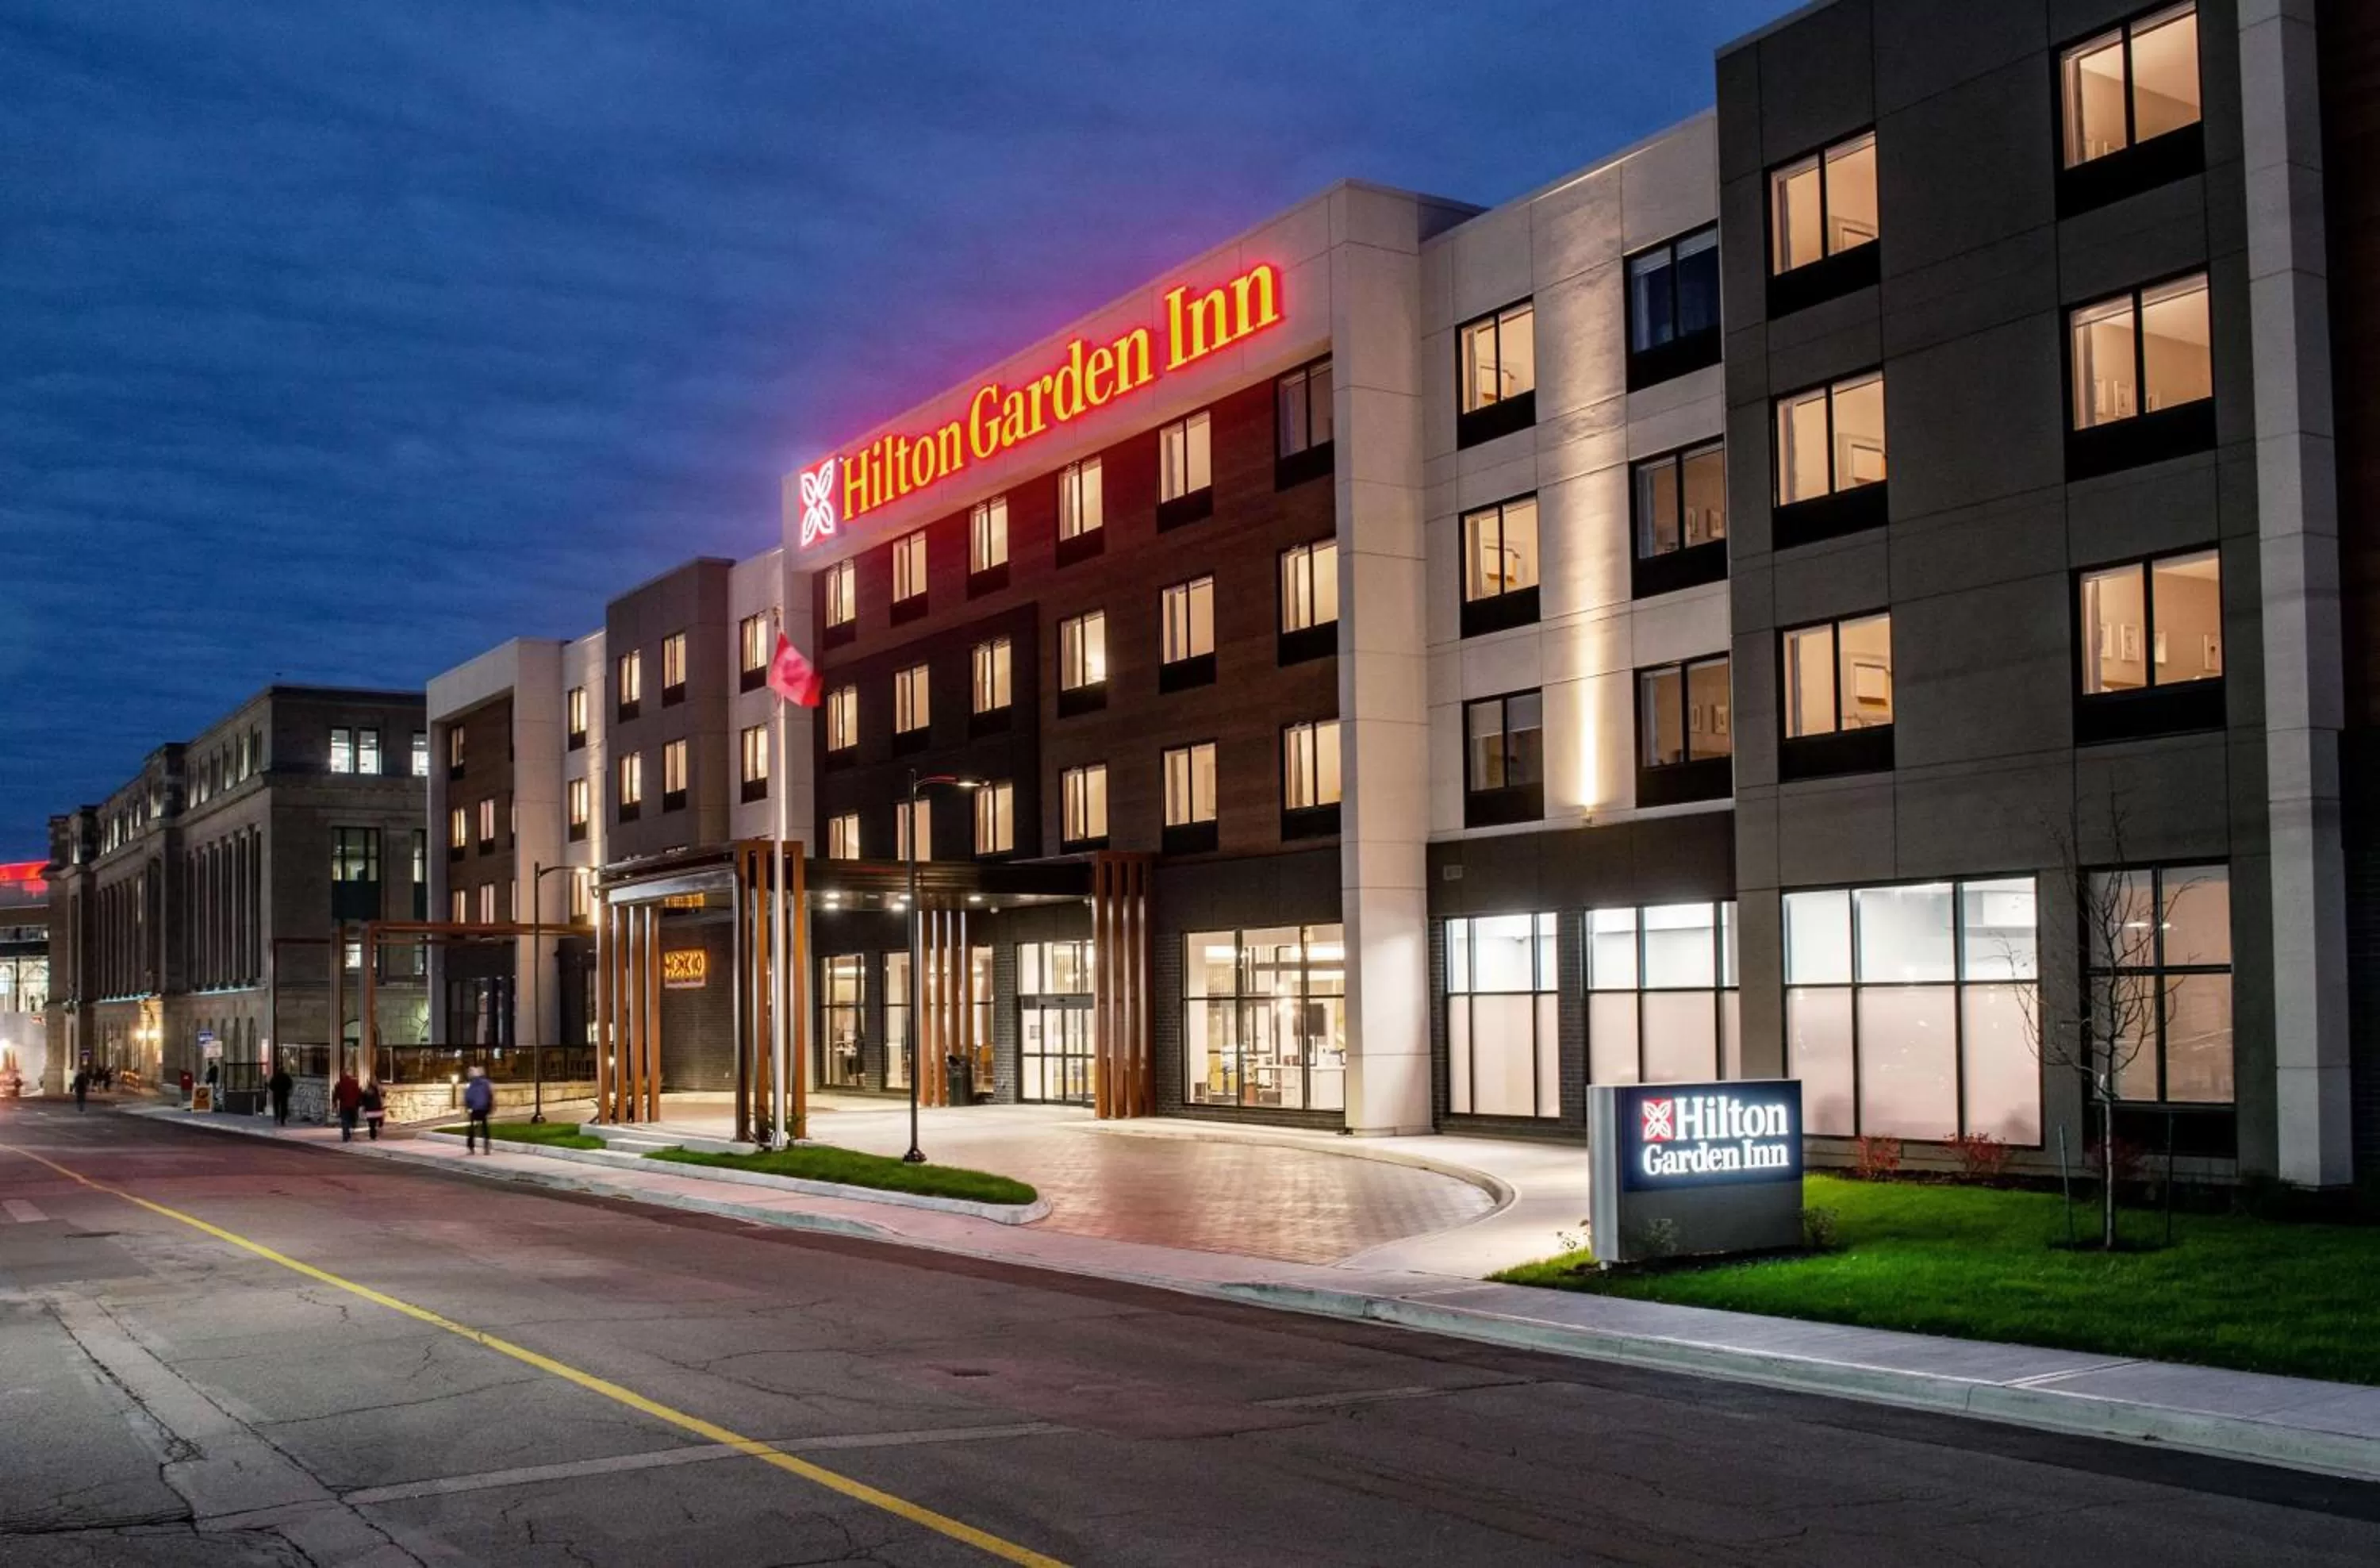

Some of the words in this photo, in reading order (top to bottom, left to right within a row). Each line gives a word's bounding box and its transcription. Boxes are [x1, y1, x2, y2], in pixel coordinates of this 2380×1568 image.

[843, 421, 963, 520] Hilton
[969, 327, 1153, 458] Garden
[1165, 264, 1279, 371] Inn
[1675, 1096, 1789, 1140] Hilton
[1644, 1143, 1741, 1176] Garden
[1742, 1139, 1789, 1169] Inn
